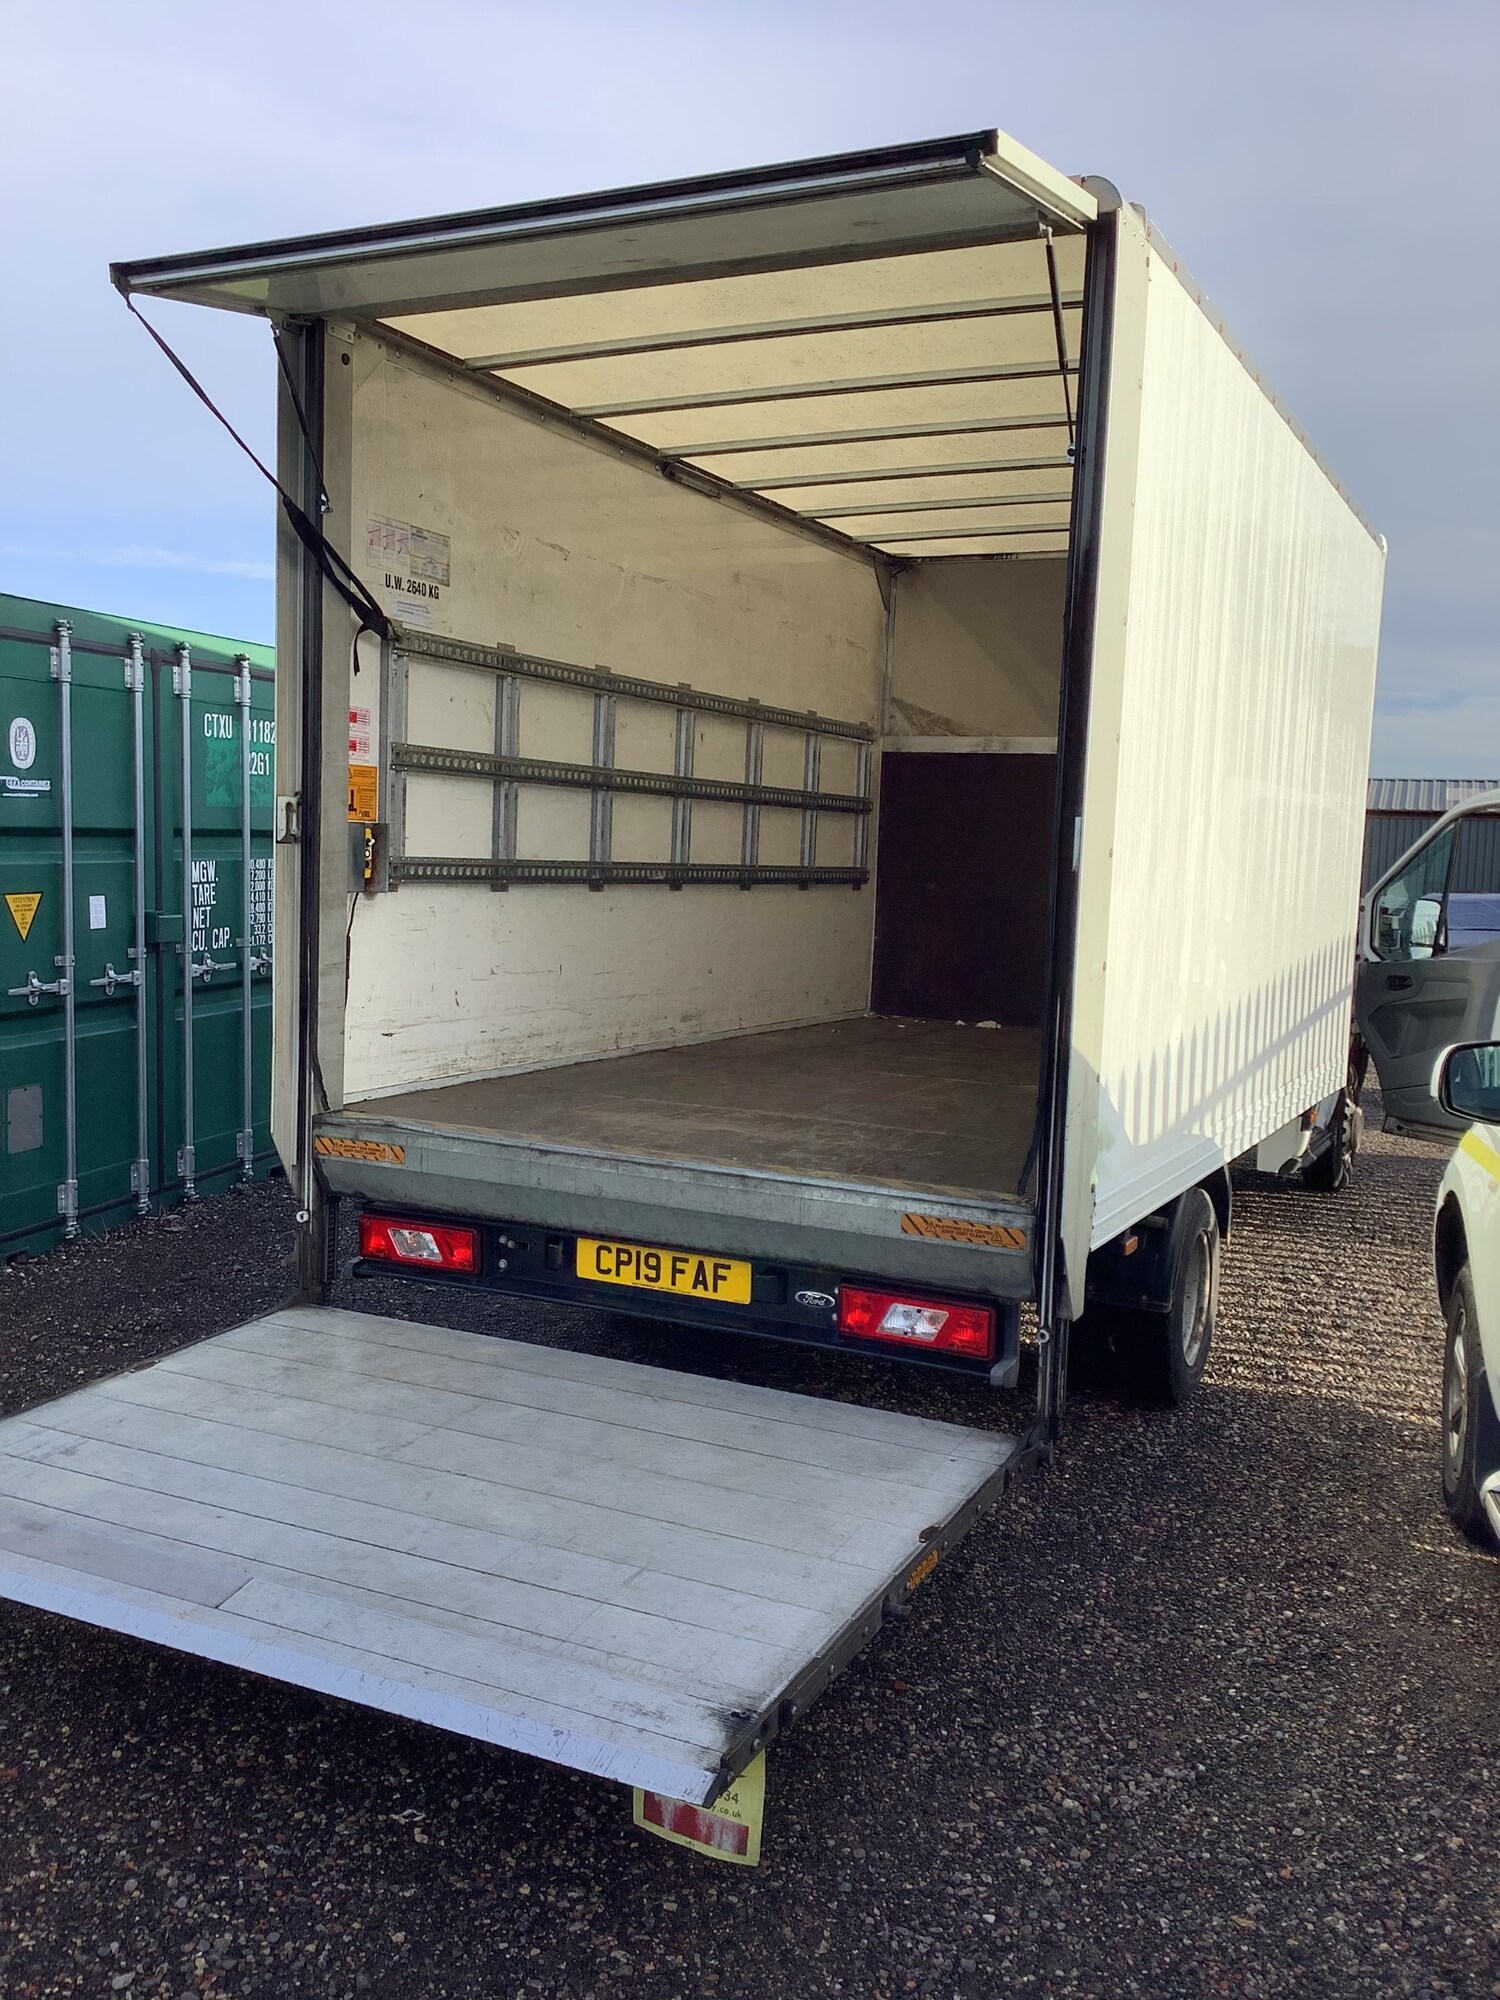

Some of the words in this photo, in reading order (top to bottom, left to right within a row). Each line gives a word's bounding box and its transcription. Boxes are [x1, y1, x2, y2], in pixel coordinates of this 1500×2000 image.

[385, 573, 404, 591] U.W.
[407, 579, 427, 597] 2640
[428, 584, 439, 600] KG
[204, 713, 232, 739] CTXU
[249, 751, 269, 776] 2G1
[192, 860, 219, 883] MGW.
[192, 883, 217, 906] TARE
[193, 906, 211, 929] NET
[192, 929, 208, 952] CU.
[212, 926, 233, 949] CAP.
[595, 1245, 661, 1283] CP19
[671, 1256, 731, 1293] FAF
[803, 1293, 827, 1306] Ford
